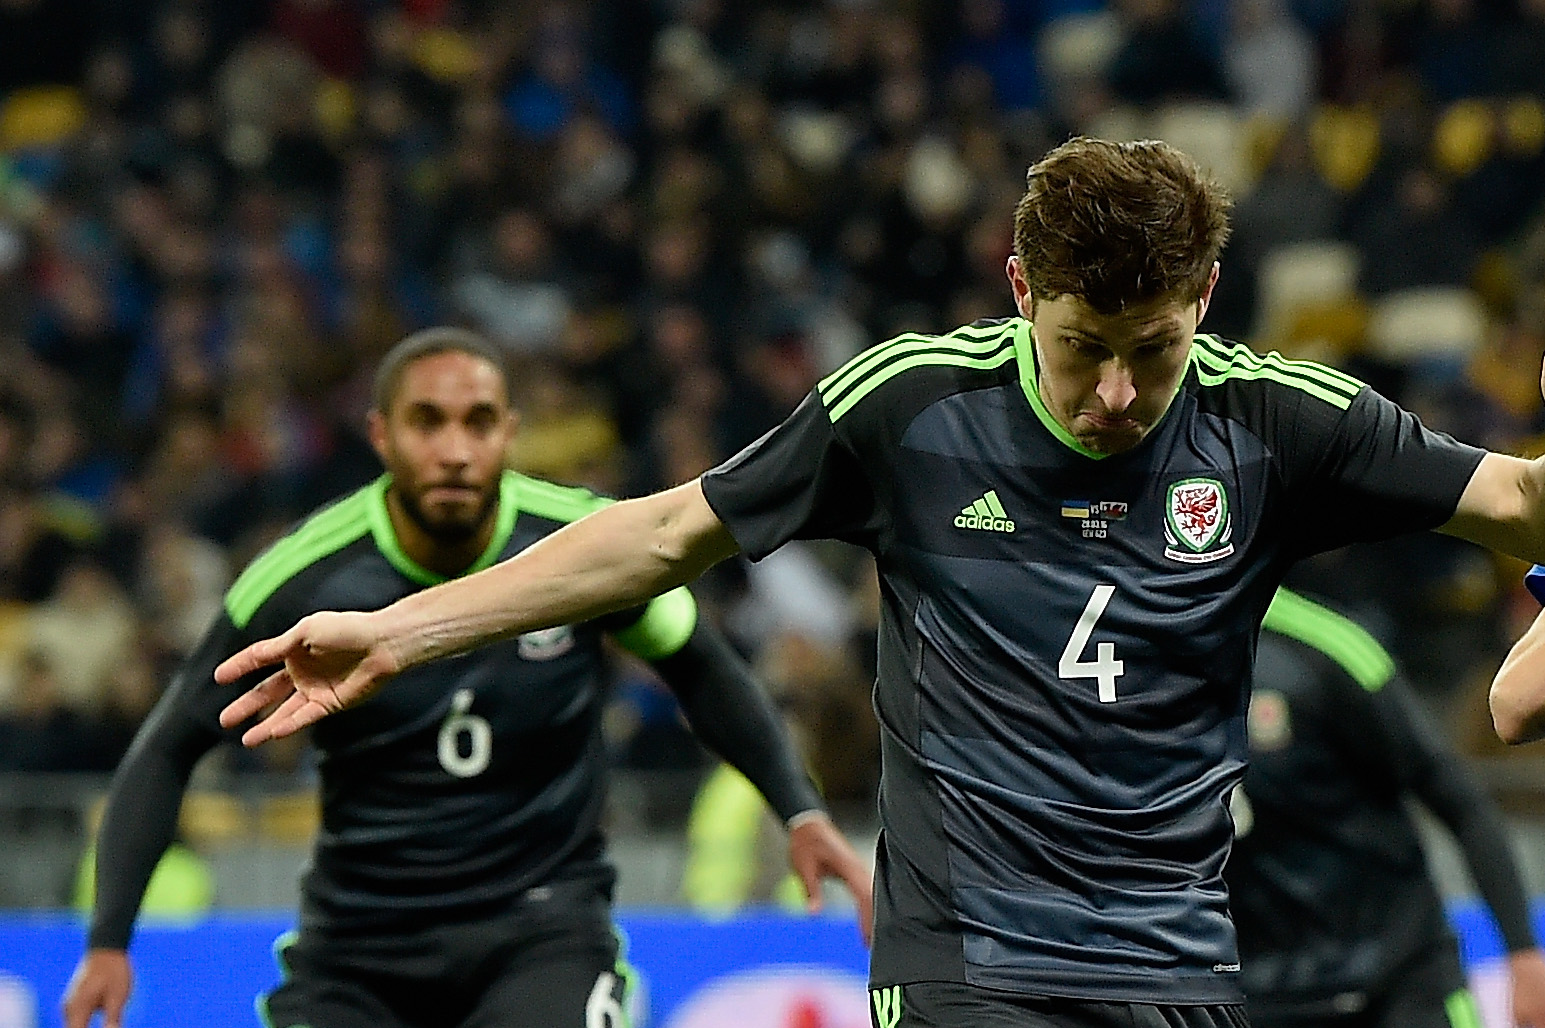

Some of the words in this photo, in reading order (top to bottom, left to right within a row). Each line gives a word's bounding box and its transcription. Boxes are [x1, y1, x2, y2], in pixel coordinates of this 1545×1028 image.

[953, 514, 1016, 533] adidas
[1058, 584, 1124, 702] 4
[437, 688, 493, 778] 6
